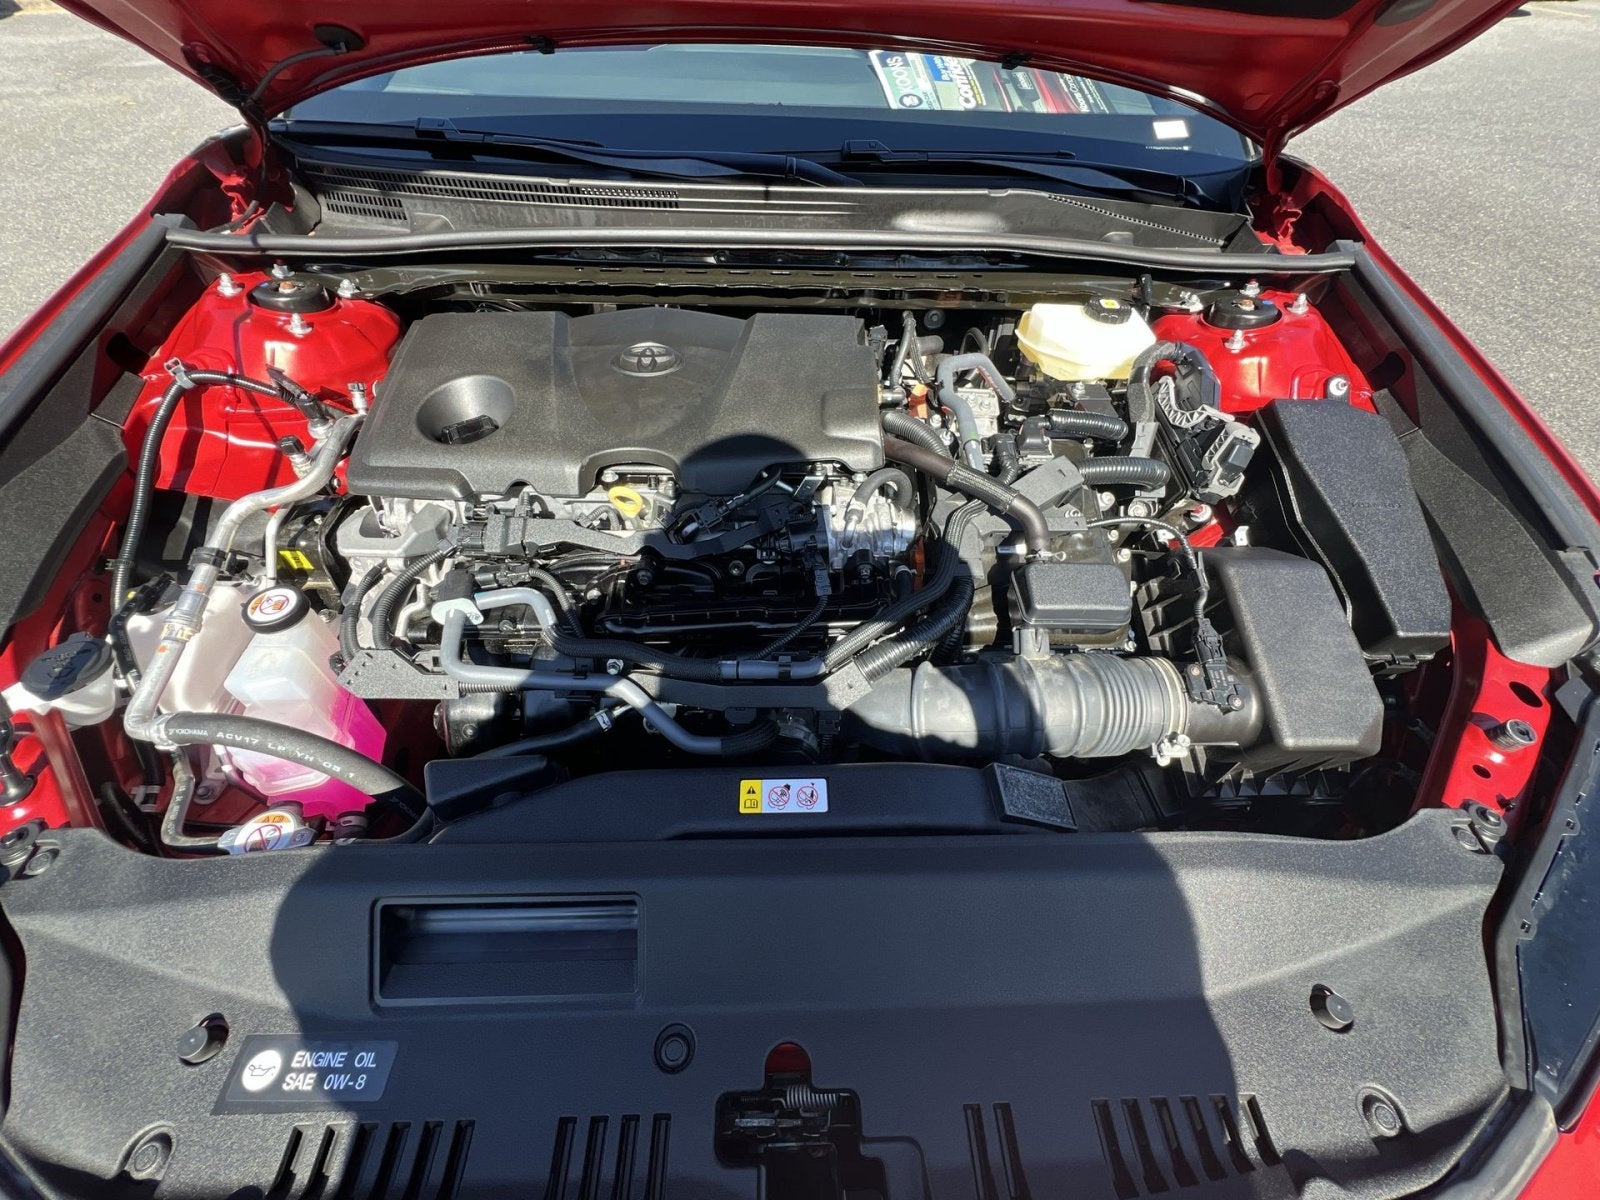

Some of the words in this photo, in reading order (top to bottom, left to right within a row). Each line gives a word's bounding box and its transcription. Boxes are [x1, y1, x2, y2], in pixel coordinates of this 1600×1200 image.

[886, 55, 914, 92] KOONS
[168, 727, 209, 737] YOKOHAMA
[216, 731, 260, 746] ACV17
[267, 742, 287, 751] LP
[296, 749, 315, 762] YH
[291, 1050, 348, 1068] ENGINE
[354, 1051, 377, 1068] OIL
[281, 1072, 317, 1091] SAE
[323, 1073, 368, 1091] 0W-8
